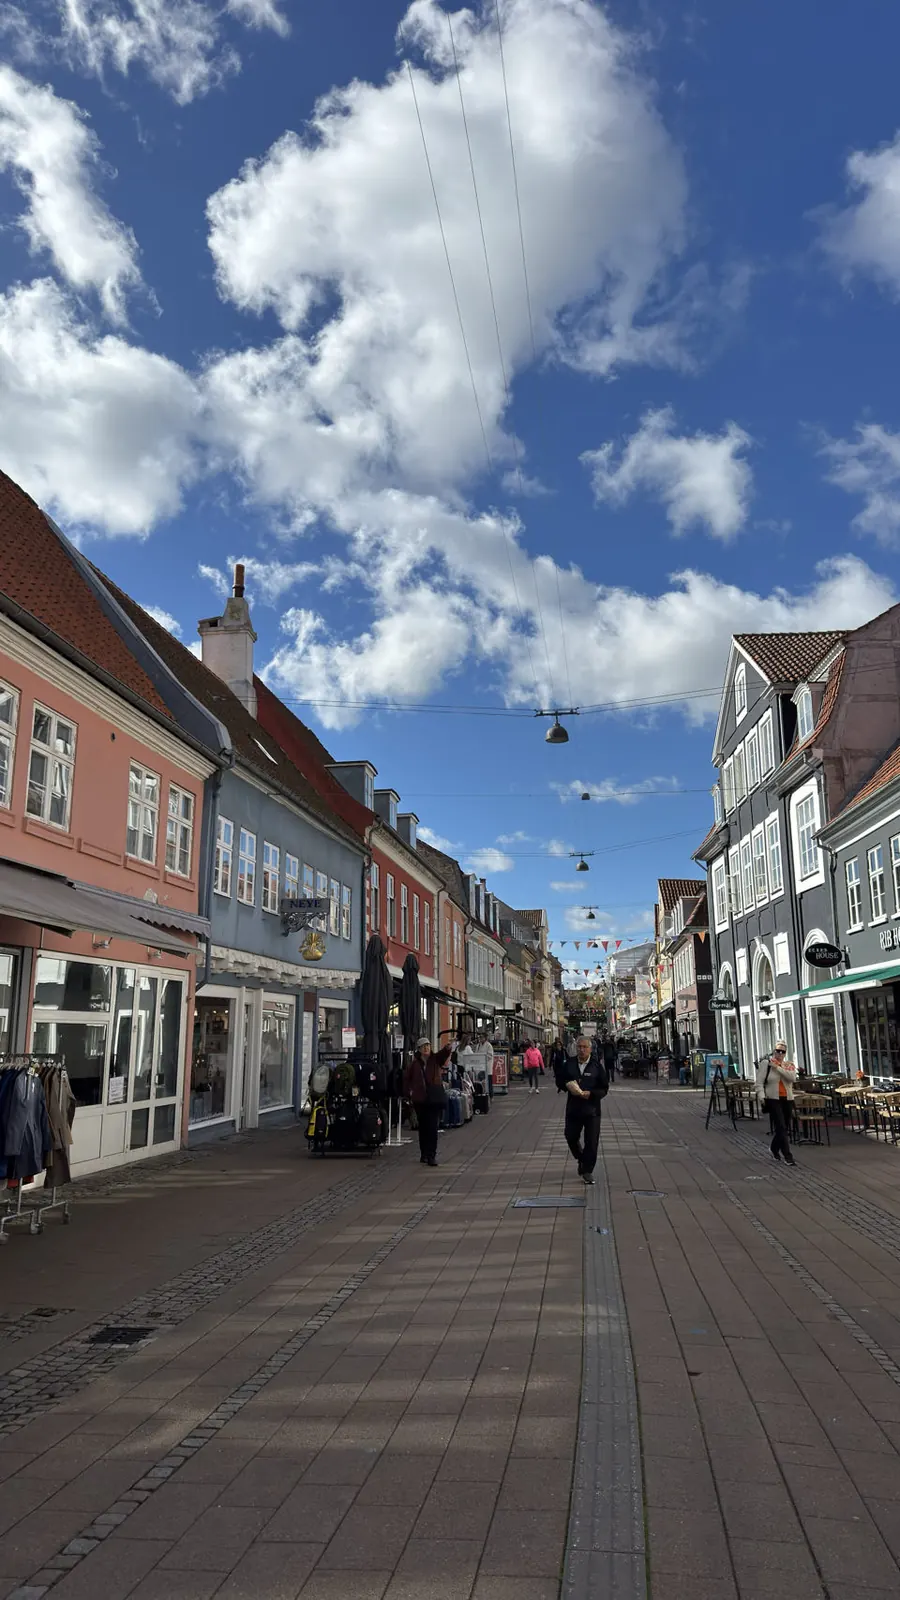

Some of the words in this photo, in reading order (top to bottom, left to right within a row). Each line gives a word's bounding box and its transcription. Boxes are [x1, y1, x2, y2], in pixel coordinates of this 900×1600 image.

[288, 899, 321, 909] NEYE
[879, 929, 892, 950] RIB
[816, 951, 839, 960] HOUSE
[711, 1001, 732, 1009] Normal
[494, 1056, 506, 1084] SALE
